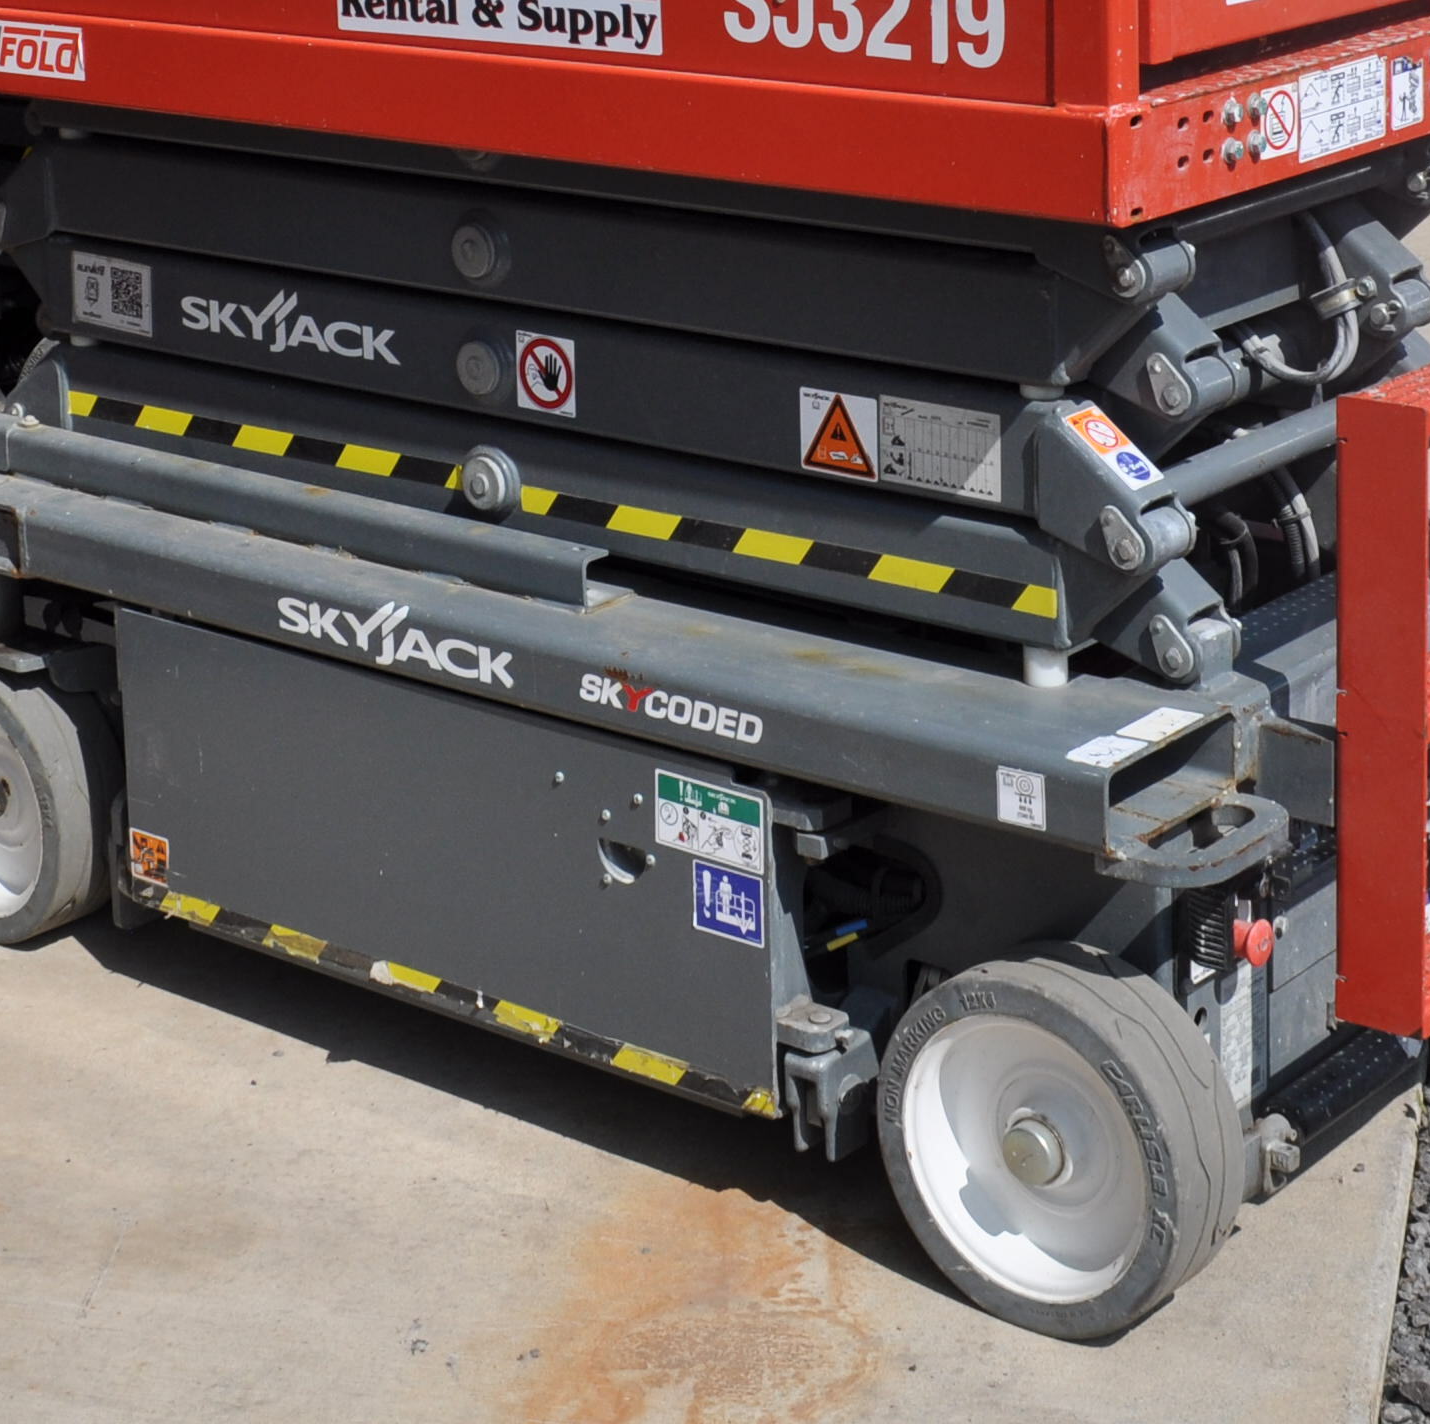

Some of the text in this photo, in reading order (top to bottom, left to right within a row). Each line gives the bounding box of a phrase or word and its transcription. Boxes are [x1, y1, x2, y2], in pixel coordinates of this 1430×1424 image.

[181, 289, 400, 366] SKYJACK
[279, 597, 514, 688] SKYJACK
[580, 673, 763, 745] SKYCODED
[891, 1005, 946, 1077] MARKING
